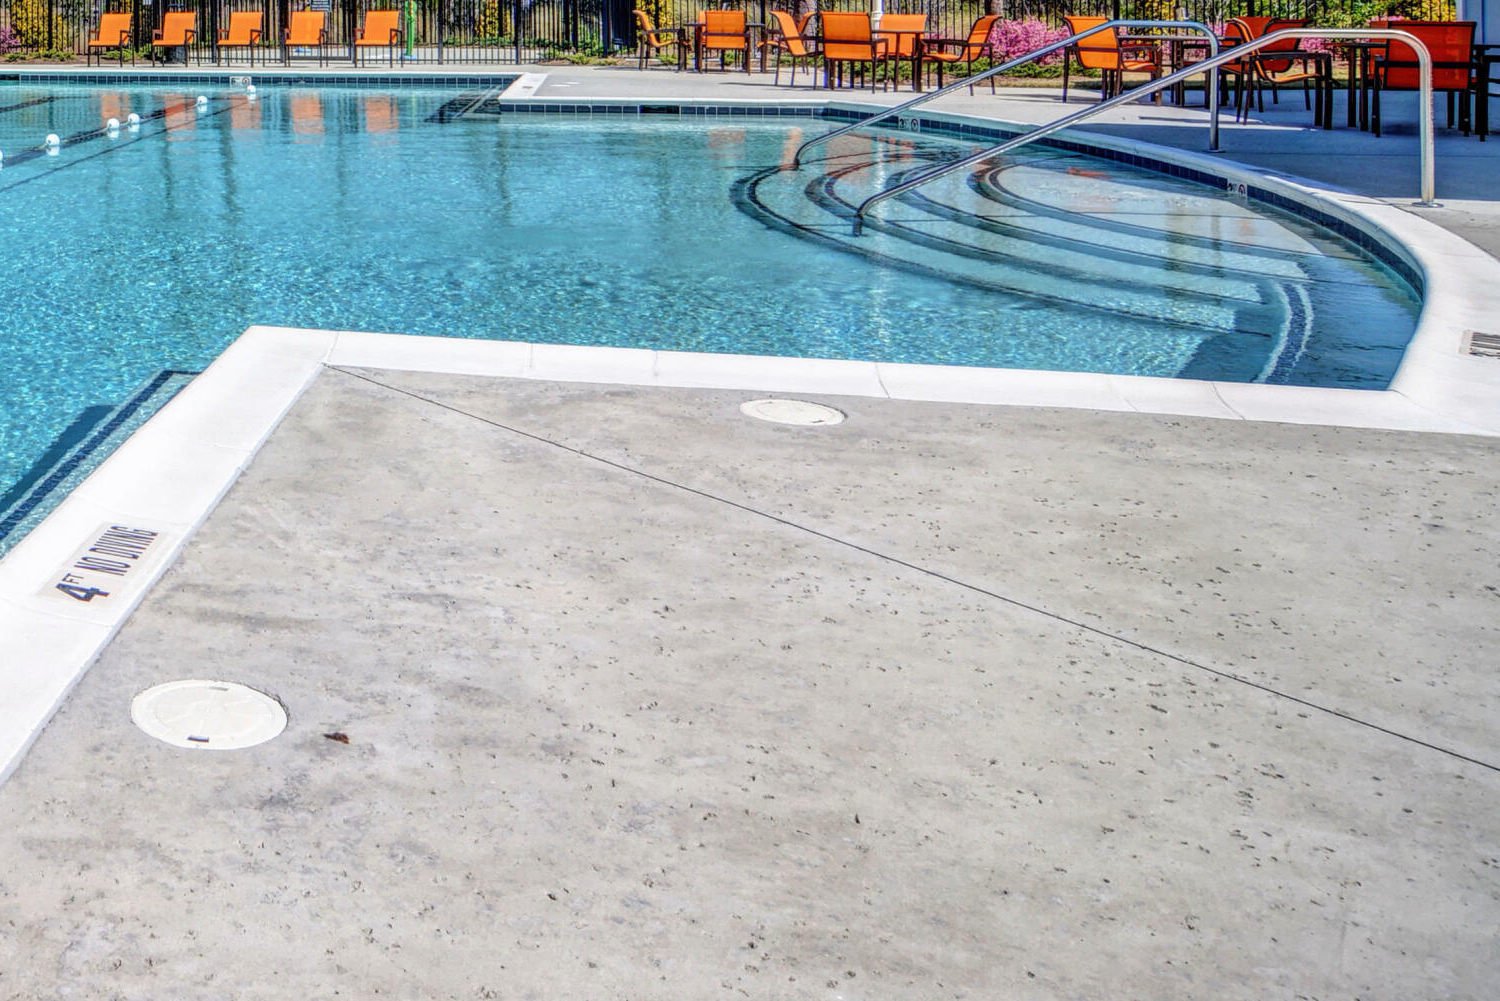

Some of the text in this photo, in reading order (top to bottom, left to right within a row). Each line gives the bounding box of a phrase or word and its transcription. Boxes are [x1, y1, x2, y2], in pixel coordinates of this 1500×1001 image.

[56, 525, 158, 602] 4 FT NO DIVING
